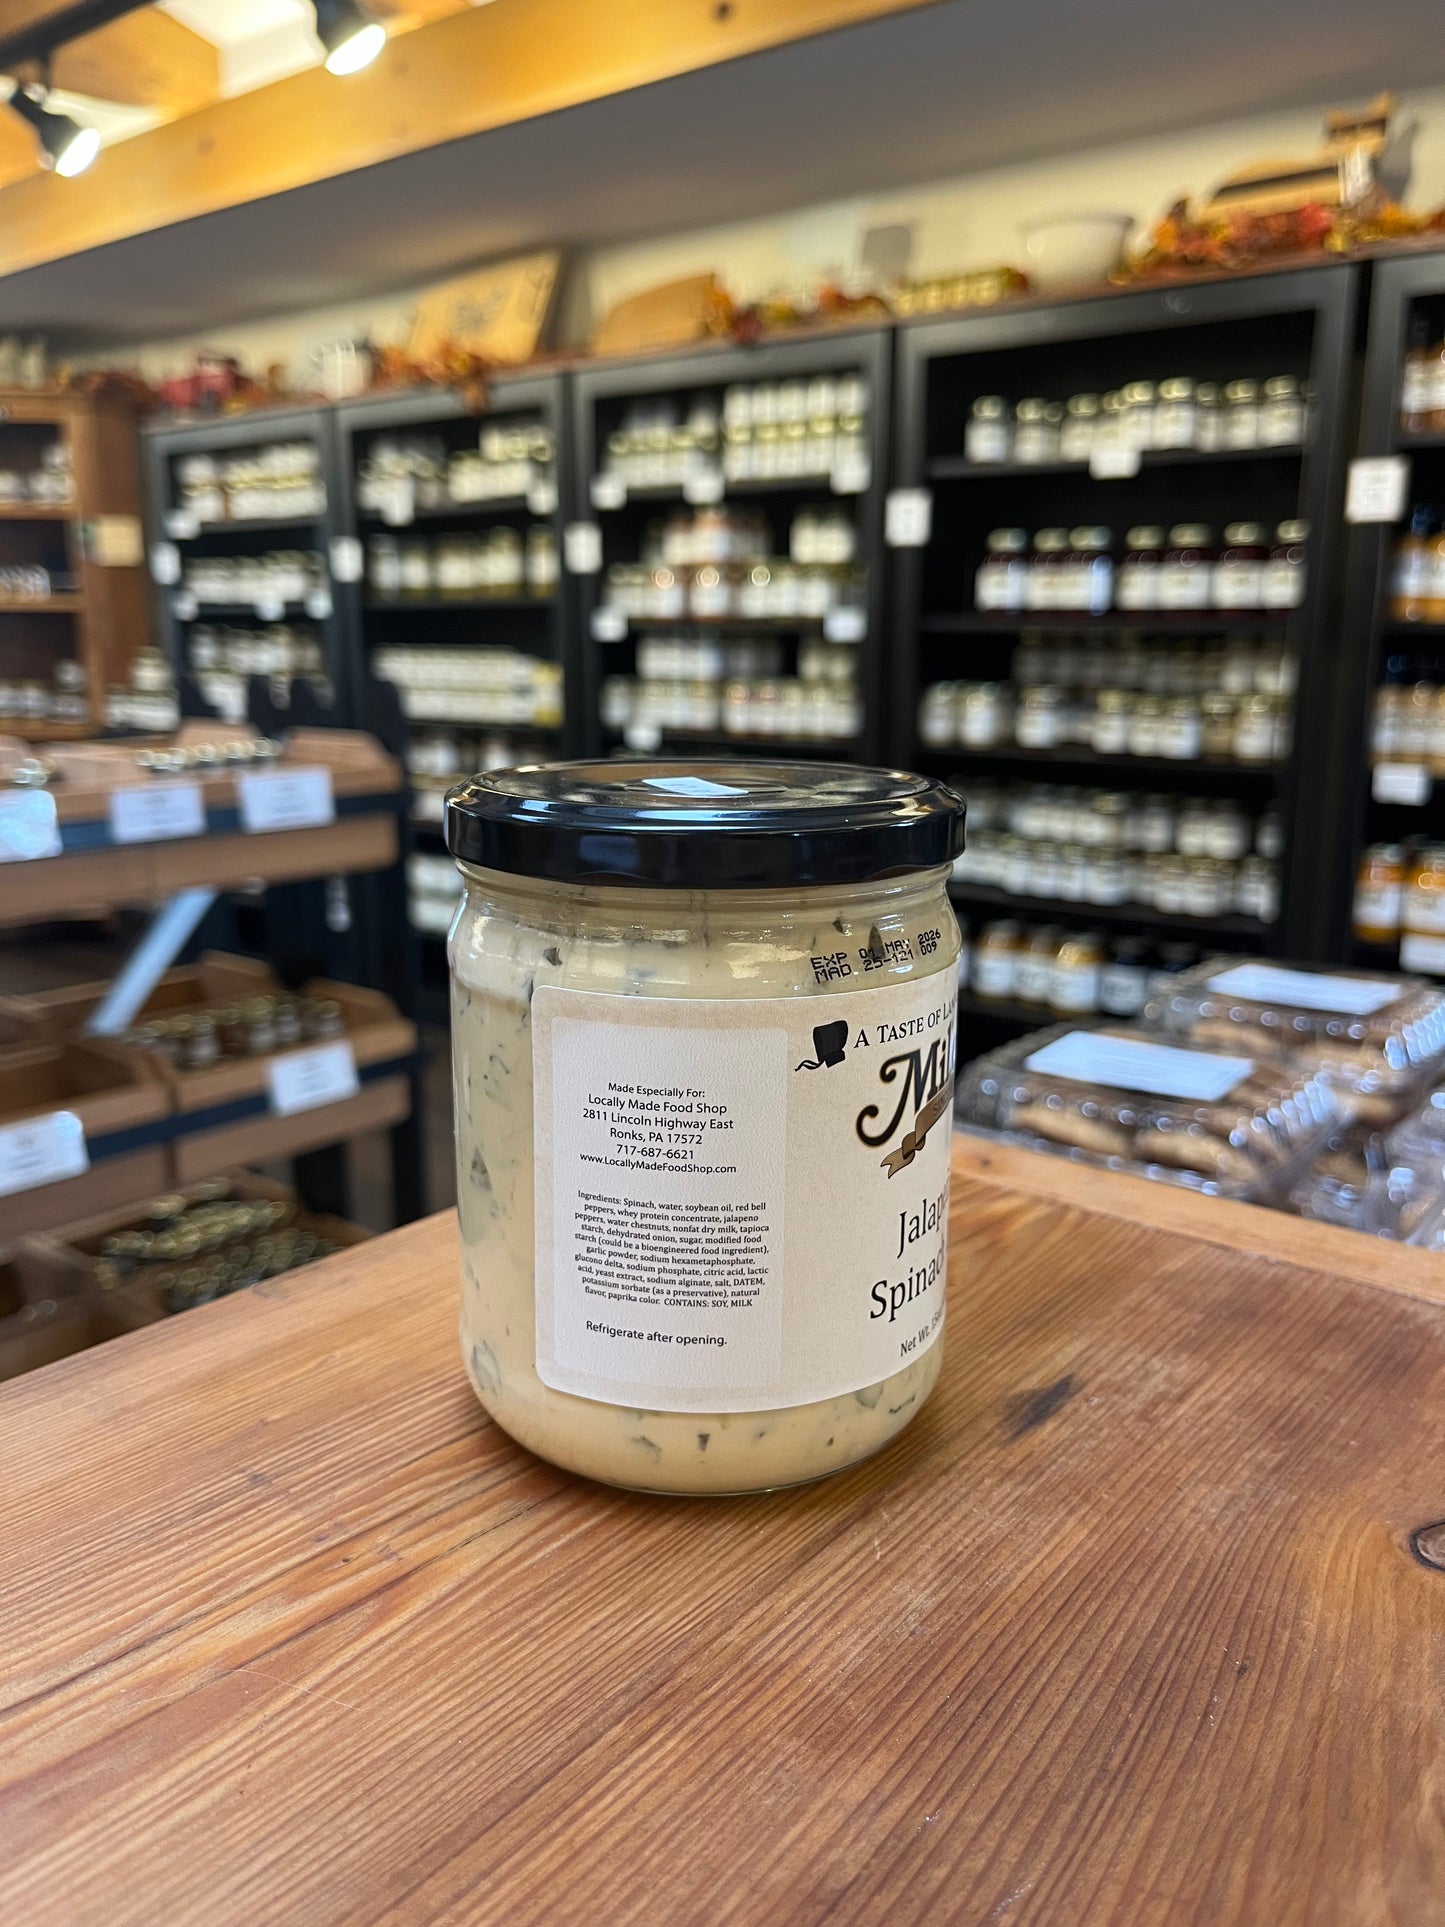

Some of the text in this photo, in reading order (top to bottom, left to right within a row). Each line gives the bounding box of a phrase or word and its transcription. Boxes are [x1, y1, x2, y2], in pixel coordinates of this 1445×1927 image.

[811, 952, 847, 970] EXP
[885, 939, 910, 953] MAY
[918, 929, 941, 945] 2026
[815, 942, 937, 983] MAD 25-121 009
[854, 1029, 870, 1048] A
[877, 1017, 924, 1043] TASTE
[928, 1009, 941, 1028] OF
[608, 1083, 705, 1098] Made Especially For:
[589, 1094, 727, 1115] Locally Made Food Shop
[583, 1109, 733, 1131] 2811 Lincoln Highway East
[610, 1128, 702, 1144] Ronks, PA 17572
[617, 1144, 694, 1159] 717-687-6621
[580, 1153, 736, 1174] www.LocallyMadeFoodShop.com
[578, 1190, 621, 1205] Ingredients:
[624, 1198, 656, 1209] Spinach,
[685, 1204, 718, 1212] soybean
[575, 1212, 605, 1224] peppers,
[631, 1221, 671, 1232] chestnuts,
[702, 1226, 715, 1234] dry
[718, 1225, 738, 1233] milk,
[740, 1225, 769, 1233] tapioca
[585, 1204, 615, 1215] peppers,
[618, 1209, 638, 1219] whey
[724, 1215, 758, 1224] jalapeno
[575, 1233, 596, 1242] starch
[599, 1236, 621, 1246] (could
[624, 1240, 633, 1248] be
[642, 1243, 699, 1254] bioengineered
[722, 1245, 769, 1256] ingredient),
[581, 1224, 604, 1234] starch,
[607, 1228, 650, 1240] dehydrated
[679, 1237, 703, 1245] sugar,
[575, 1253, 602, 1264] glucono
[604, 1259, 625, 1269] delta,
[627, 1263, 655, 1272] sodium
[658, 1266, 701, 1276] phosphate,
[587, 1246, 755, 1267] garlic powder, sodium hexametaphosphate,
[578, 1265, 594, 1274] acid,
[596, 1268, 614, 1277] yeast
[616, 1273, 645, 1282] extract,
[647, 1276, 676, 1284] sodium
[678, 1278, 712, 1287] alginate,
[734, 1277, 765, 1286] DATEM,
[582, 1276, 619, 1288] potassium
[621, 1283, 650, 1292] sorbate
[652, 1286, 664, 1295] (as
[673, 1289, 729, 1298] preservative),
[731, 1288, 759, 1296] natural
[585, 1286, 606, 1297] flavor,
[608, 1292, 637, 1302] paprika
[639, 1296, 660, 1304] color.
[664, 1298, 709, 1307] CONTAINS:
[587, 1321, 727, 1347] Refrigerate after opening.
[900, 1336, 916, 1356] Net
